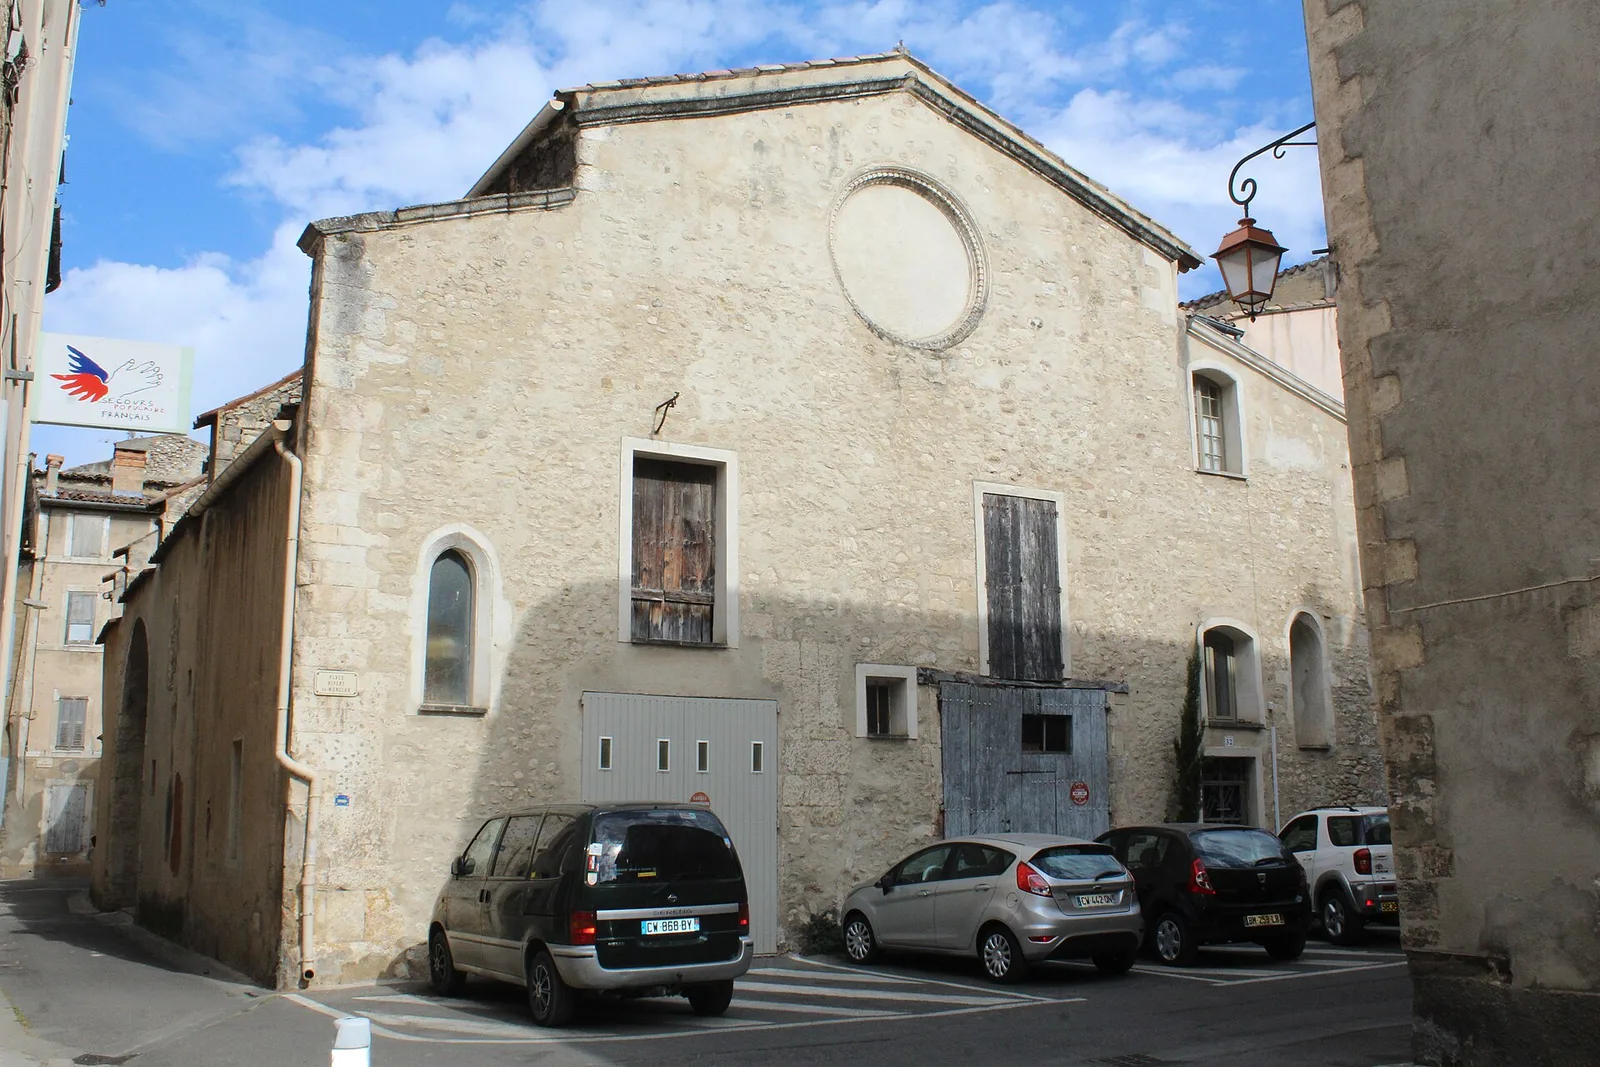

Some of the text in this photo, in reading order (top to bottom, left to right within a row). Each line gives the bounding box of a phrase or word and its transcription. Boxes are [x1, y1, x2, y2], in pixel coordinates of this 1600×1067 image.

[101, 397, 154, 406] SECOURS
[114, 404, 165, 413] POPULAIRE
[101, 410, 150, 421] FRANÇAIS
